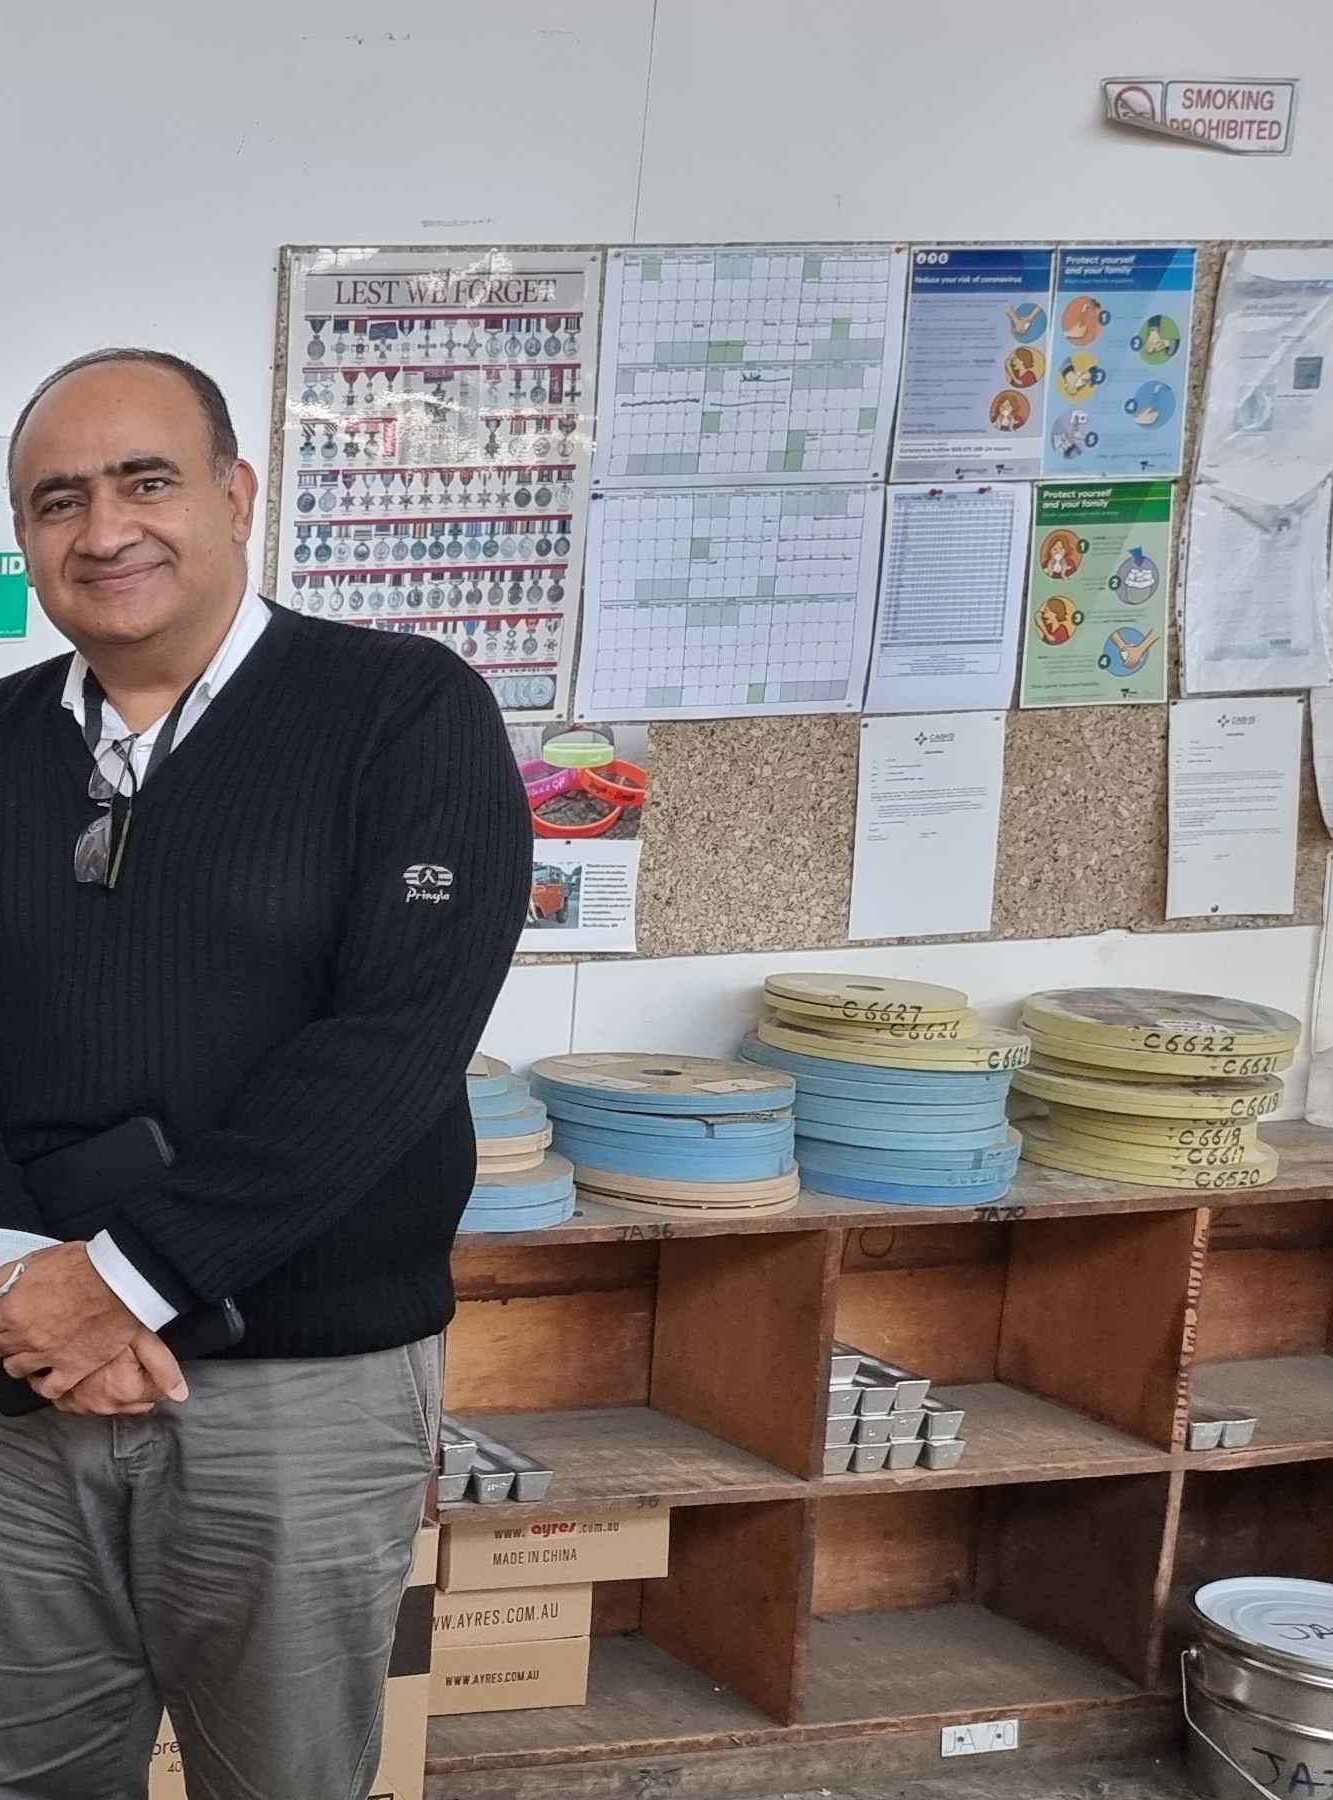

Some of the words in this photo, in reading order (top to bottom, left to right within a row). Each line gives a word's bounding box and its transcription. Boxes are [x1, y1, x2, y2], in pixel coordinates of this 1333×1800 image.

[1181, 88, 1274, 111] SMOKING
[1065, 256, 1099, 265] Protect
[1100, 254, 1136, 266] yourself
[1064, 266, 1083, 275] and
[1083, 268, 1104, 276] your
[1104, 265, 1133, 275] family
[914, 276, 940, 284] Reduce
[335, 280, 400, 305] LEST
[407, 280, 448, 305] WE
[455, 278, 557, 304] FORGET
[1043, 490, 1076, 499] Protect
[1077, 488, 1113, 499] yourself
[1042, 500, 1060, 509] and
[1060, 501, 1081, 510] your
[1081, 499, 1109, 508] family
[842, 1000, 923, 1023] C6627
[1143, 1033, 1235, 1053] C6622
[530, 1521, 577, 1538] ayres
[493, 1551, 524, 1566] MADE
[528, 1550, 539, 1564] IN
[542, 1548, 577, 1562] CHINA
[445, 1670, 540, 1687] WWW.AYRES.COM.AU
